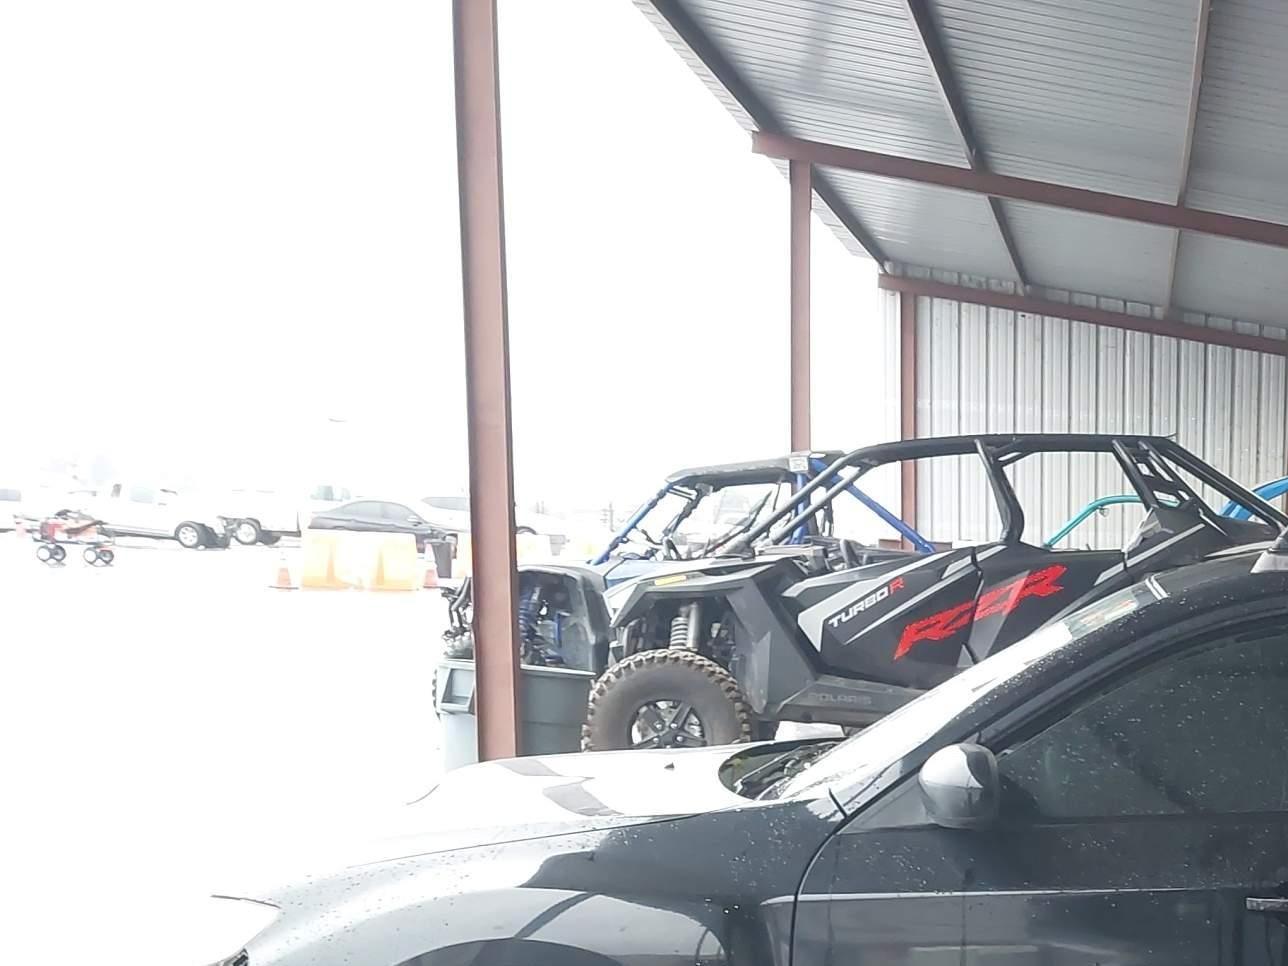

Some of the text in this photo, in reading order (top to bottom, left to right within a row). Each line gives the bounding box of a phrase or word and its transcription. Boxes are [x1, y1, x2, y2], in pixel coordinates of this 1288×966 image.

[828, 576, 905, 627] TURBO R
[894, 564, 1068, 661] RZR
